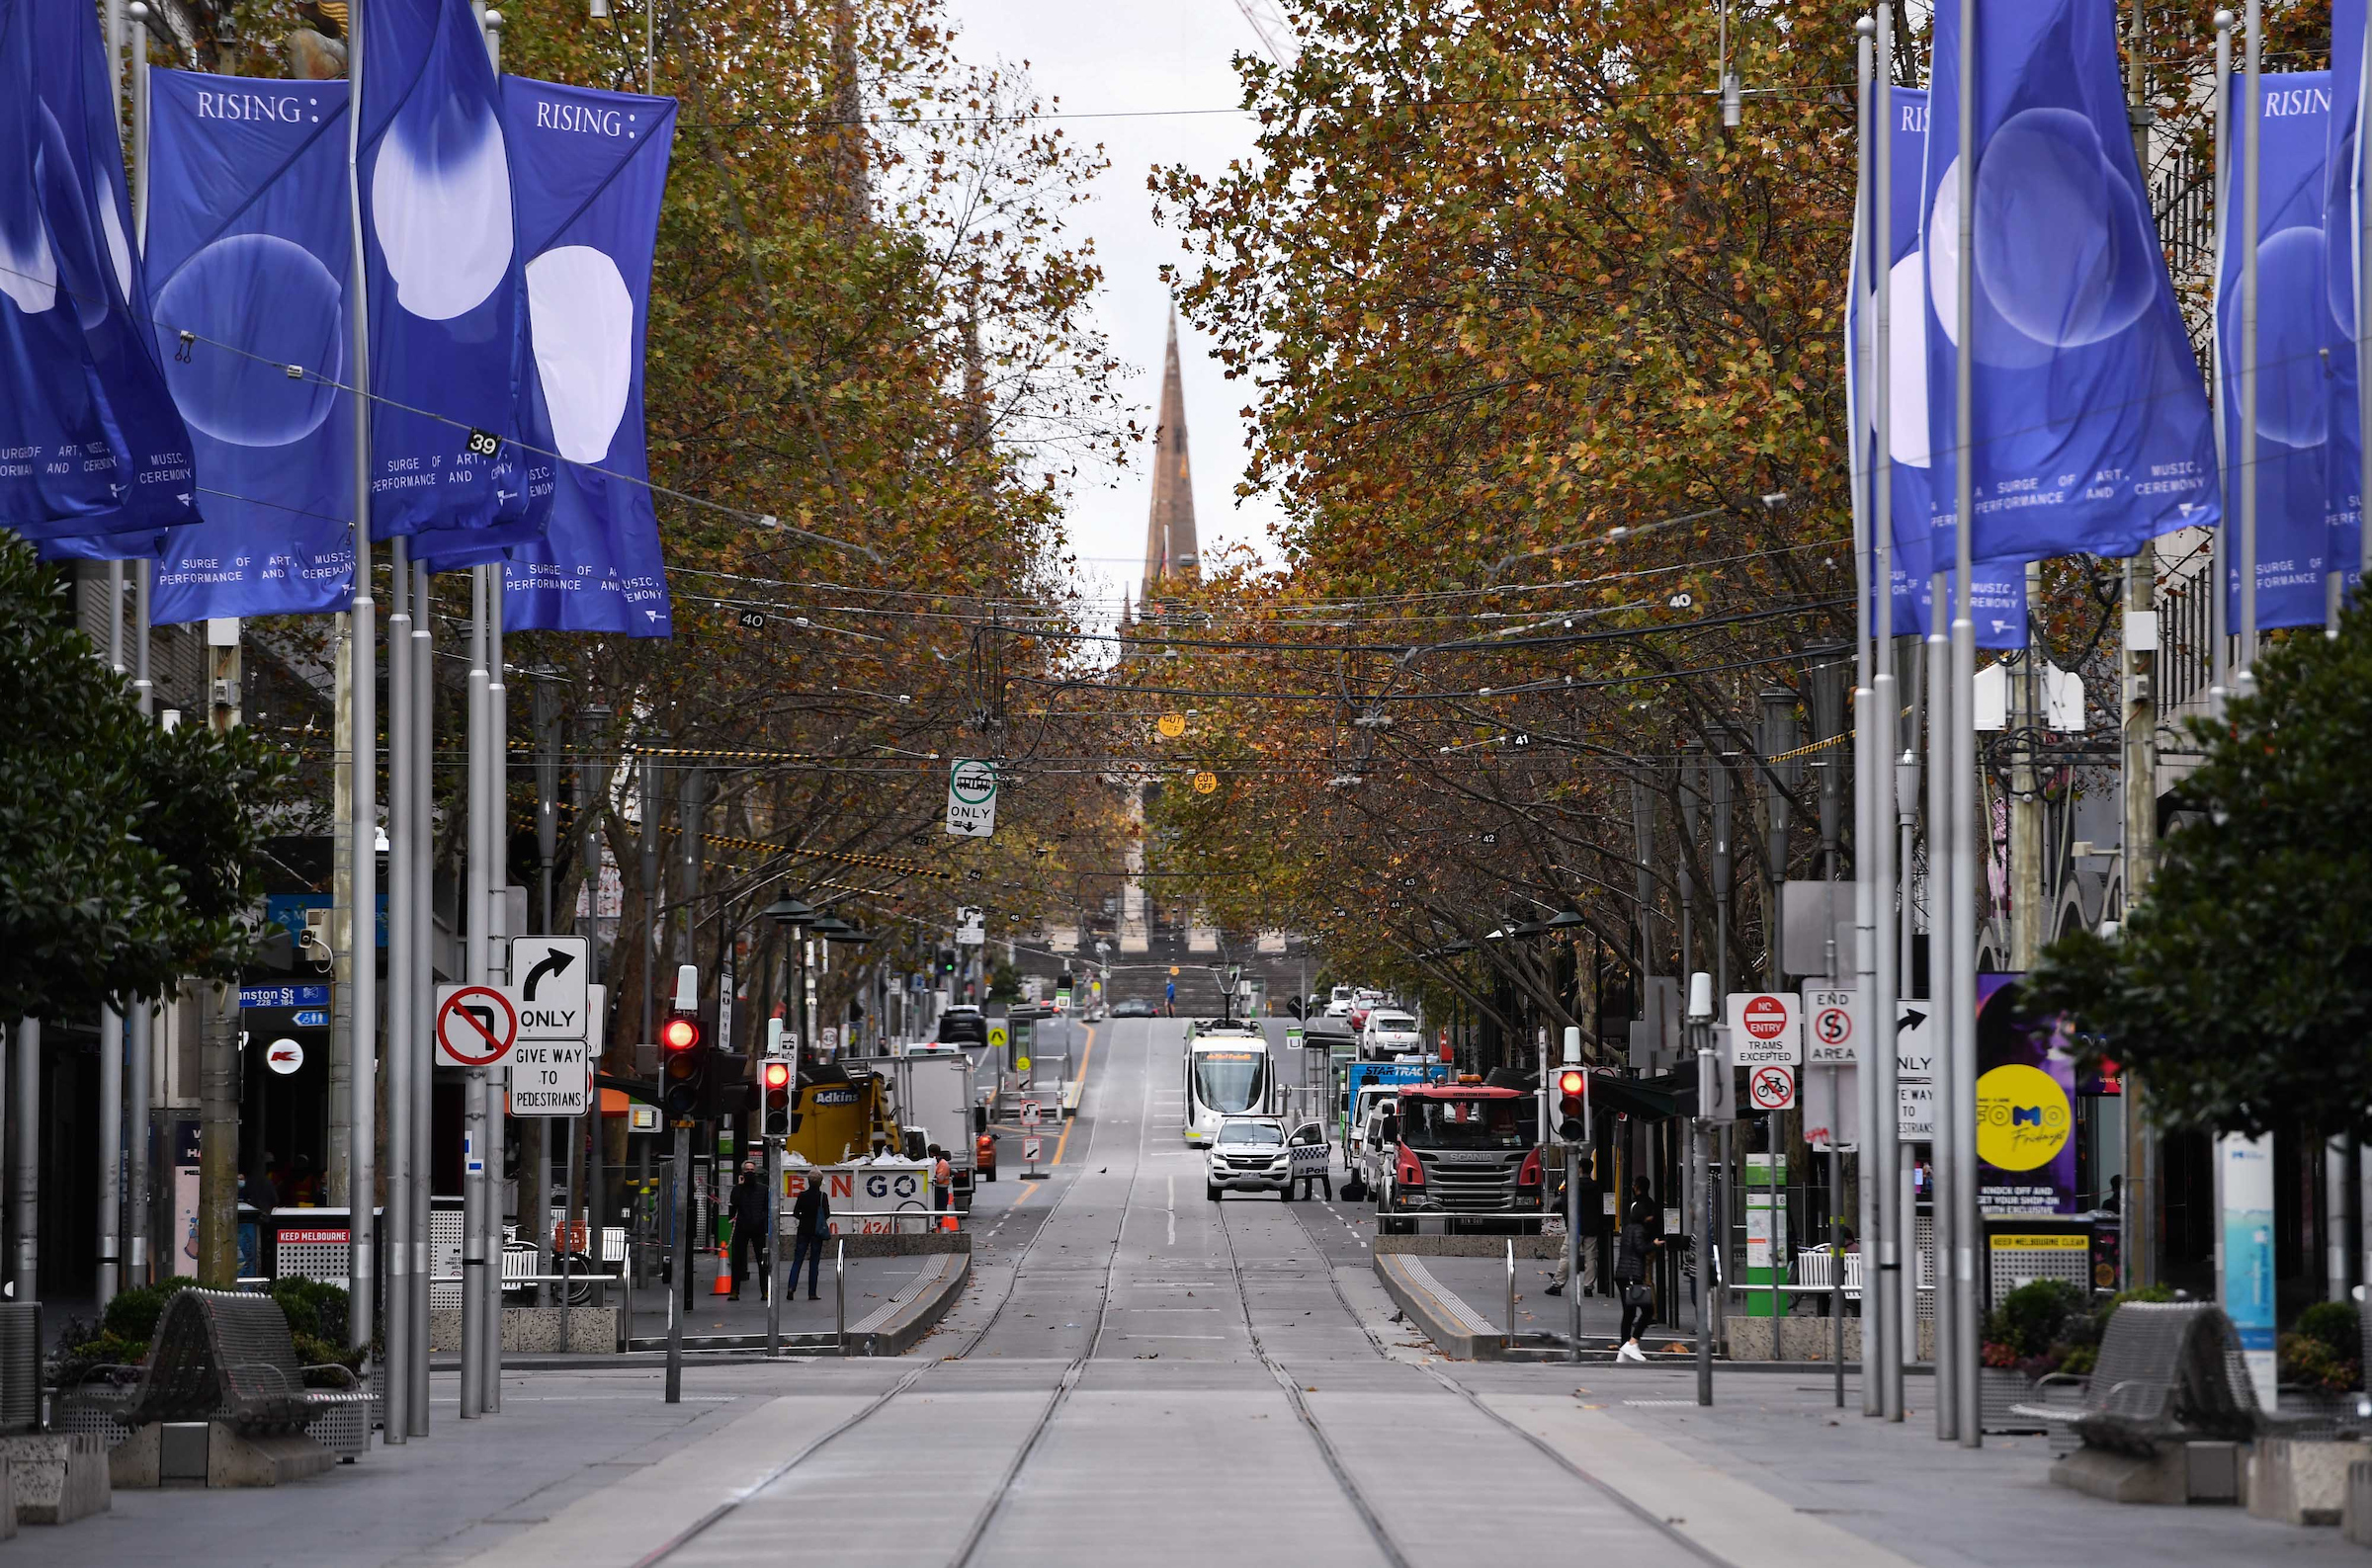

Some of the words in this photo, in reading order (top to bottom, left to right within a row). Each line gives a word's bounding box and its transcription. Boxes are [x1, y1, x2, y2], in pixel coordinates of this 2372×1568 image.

[2264, 88, 2331, 118] RISIN
[469, 433, 497, 454] 39
[150, 453, 188, 466] MUSIC,
[387, 456, 420, 472] SURGE
[431, 454, 442, 468] OF
[46, 462, 70, 474] AND
[139, 467, 192, 484] CEREMONY
[372, 472, 436, 493] PERFORMANCE
[448, 469, 473, 483] AND
[1996, 478, 2039, 493] SURGE
[2058, 473, 2076, 487] OF
[1974, 491, 2065, 515] PERFORMANCE
[2085, 487, 2114, 500] AND
[2134, 476, 2205, 495] CEREMONY
[182, 558, 219, 570] SURGE
[236, 556, 251, 567] OF
[529, 563, 561, 575] SURGE
[576, 565, 592, 576] OF
[2255, 559, 2295, 575] SURGE
[2309, 557, 2323, 569] OF
[159, 571, 243, 585] PERFORMANCE
[261, 569, 286, 580] AND
[506, 579, 582, 592] PERFORMANCE
[600, 580, 621, 592] AND
[1668, 593, 1692, 609] 40
[742, 613, 764, 627] 40
[1515, 733, 1529, 746] 41
[1197, 774, 1213, 783] CUT
[951, 805, 991, 819] ONLY
[1482, 833, 1495, 843] 42
[1404, 877, 1416, 886] 43
[238, 988, 279, 1000] anston
[281, 988, 295, 1000] St
[1817, 994, 1849, 1006] END
[1757, 1001, 1772, 1011] NO
[521, 1011, 575, 1028] ONLY
[1749, 1024, 1782, 1033] ENTRY
[1748, 1040, 1783, 1050] TRAMS
[516, 1048, 548, 1063] GIVE
[552, 1048, 582, 1063] WAY
[1739, 1052, 1792, 1062] EXCEPTED
[1812, 1047, 1856, 1060] AREA
[1897, 1056, 1933, 1070] NLY
[541, 1070, 557, 1085] TO
[1366, 1066, 1433, 1077] STARTRACK
[517, 1092, 581, 1107] PEDESTRIANS
[815, 1091, 859, 1104] Adkins
[1902, 1106, 1915, 1116] TO
[1898, 1121, 1934, 1133] ESTRIANS
[1449, 1153, 1493, 1162] SCANIA
[1982, 1186, 2013, 1196] KNOCK
[2014, 1186, 2032, 1196] OFF
[2033, 1186, 2054, 1196] AND
[1993, 1196, 2020, 1205] YOUR
[2006, 1205, 2055, 1215] EXCLUSIVE
[280, 1231, 300, 1241] KEEP
[301, 1231, 346, 1241] MELBOURNE
